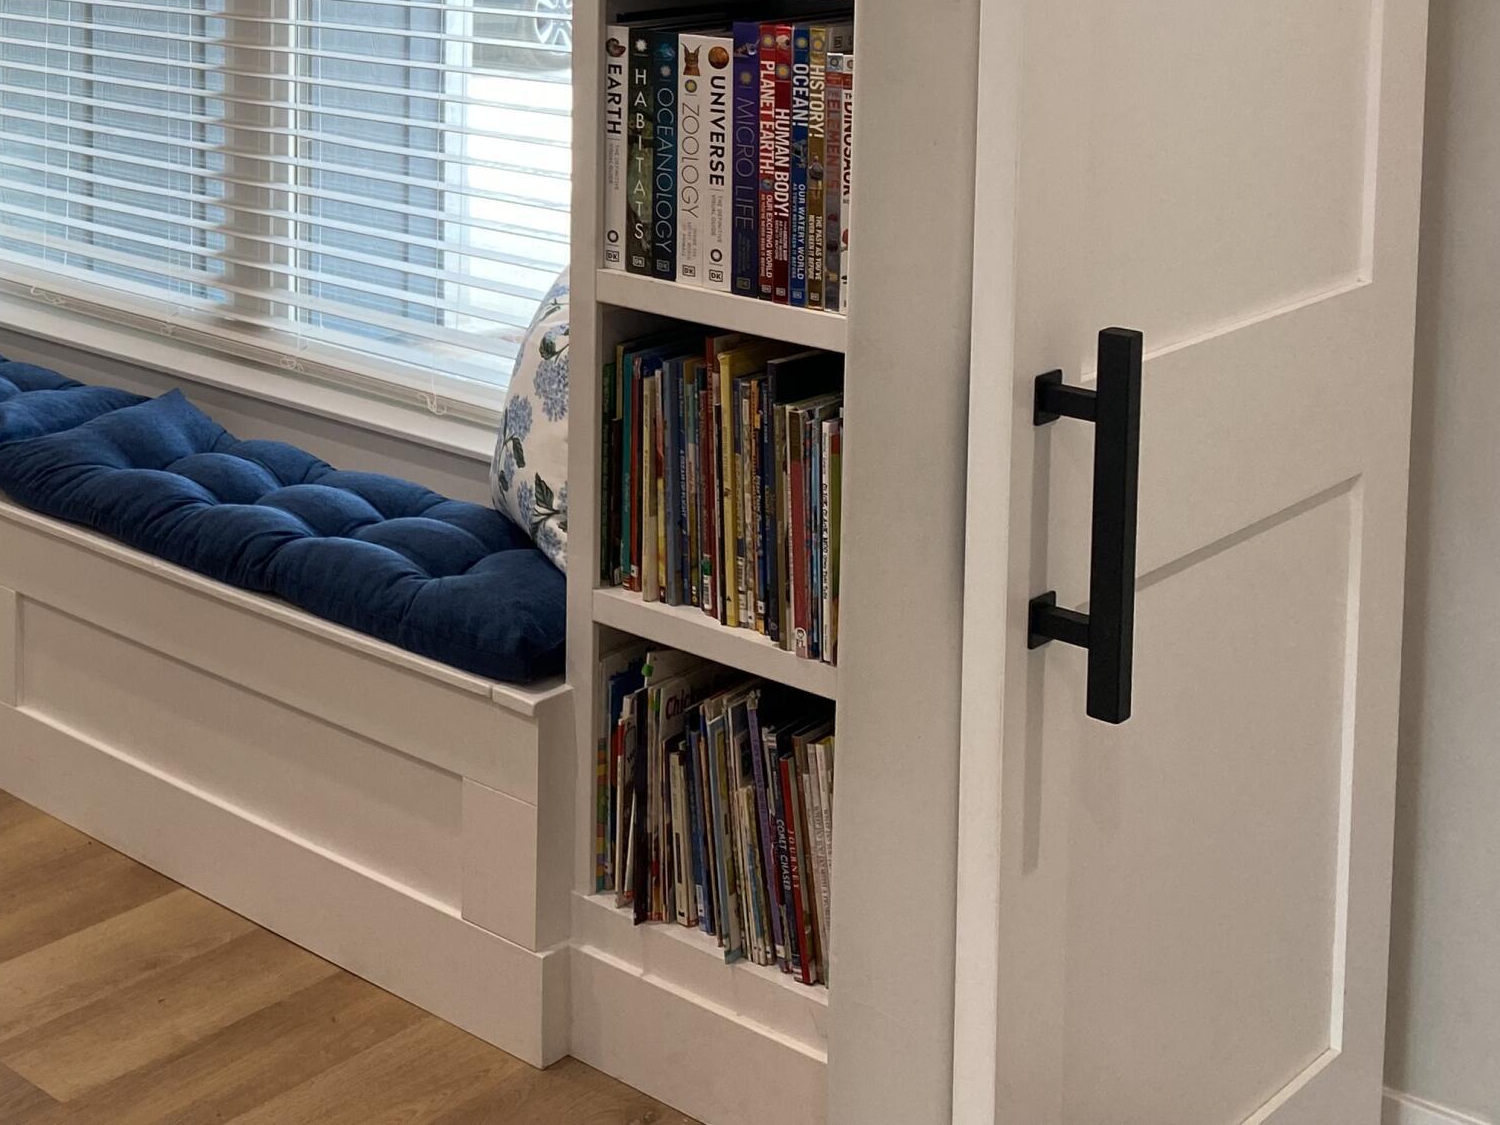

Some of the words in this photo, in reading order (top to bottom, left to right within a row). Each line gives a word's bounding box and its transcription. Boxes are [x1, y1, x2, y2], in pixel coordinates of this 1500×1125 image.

[607, 63, 622, 135] EARTH
[760, 60, 775, 120] PLANET
[792, 63, 809, 127] OCEAN!
[809, 65, 824, 138] HISTORY!
[634, 68, 648, 240] HABITATS
[682, 103, 700, 219] ZOOLOGY
[709, 76, 726, 186] UNIVERSE
[735, 97, 754, 177] MICRO
[759, 121, 774, 175] EARTH!
[774, 108, 790, 167] HUMAN
[827, 98, 841, 189] ELEMENTS
[655, 86, 674, 253] OCEANOLOGY
[773, 170, 789, 217] BODY!
[735, 184, 754, 229] LIFE
[797, 206, 805, 244] WATERY
[815, 247, 821, 256] AS
[680, 481, 686, 491] OF
[776, 819, 787, 849] COMET
[787, 828, 799, 890] JOURNEY
[779, 853, 792, 891] CHASER
[819, 869, 828, 888] WITH
